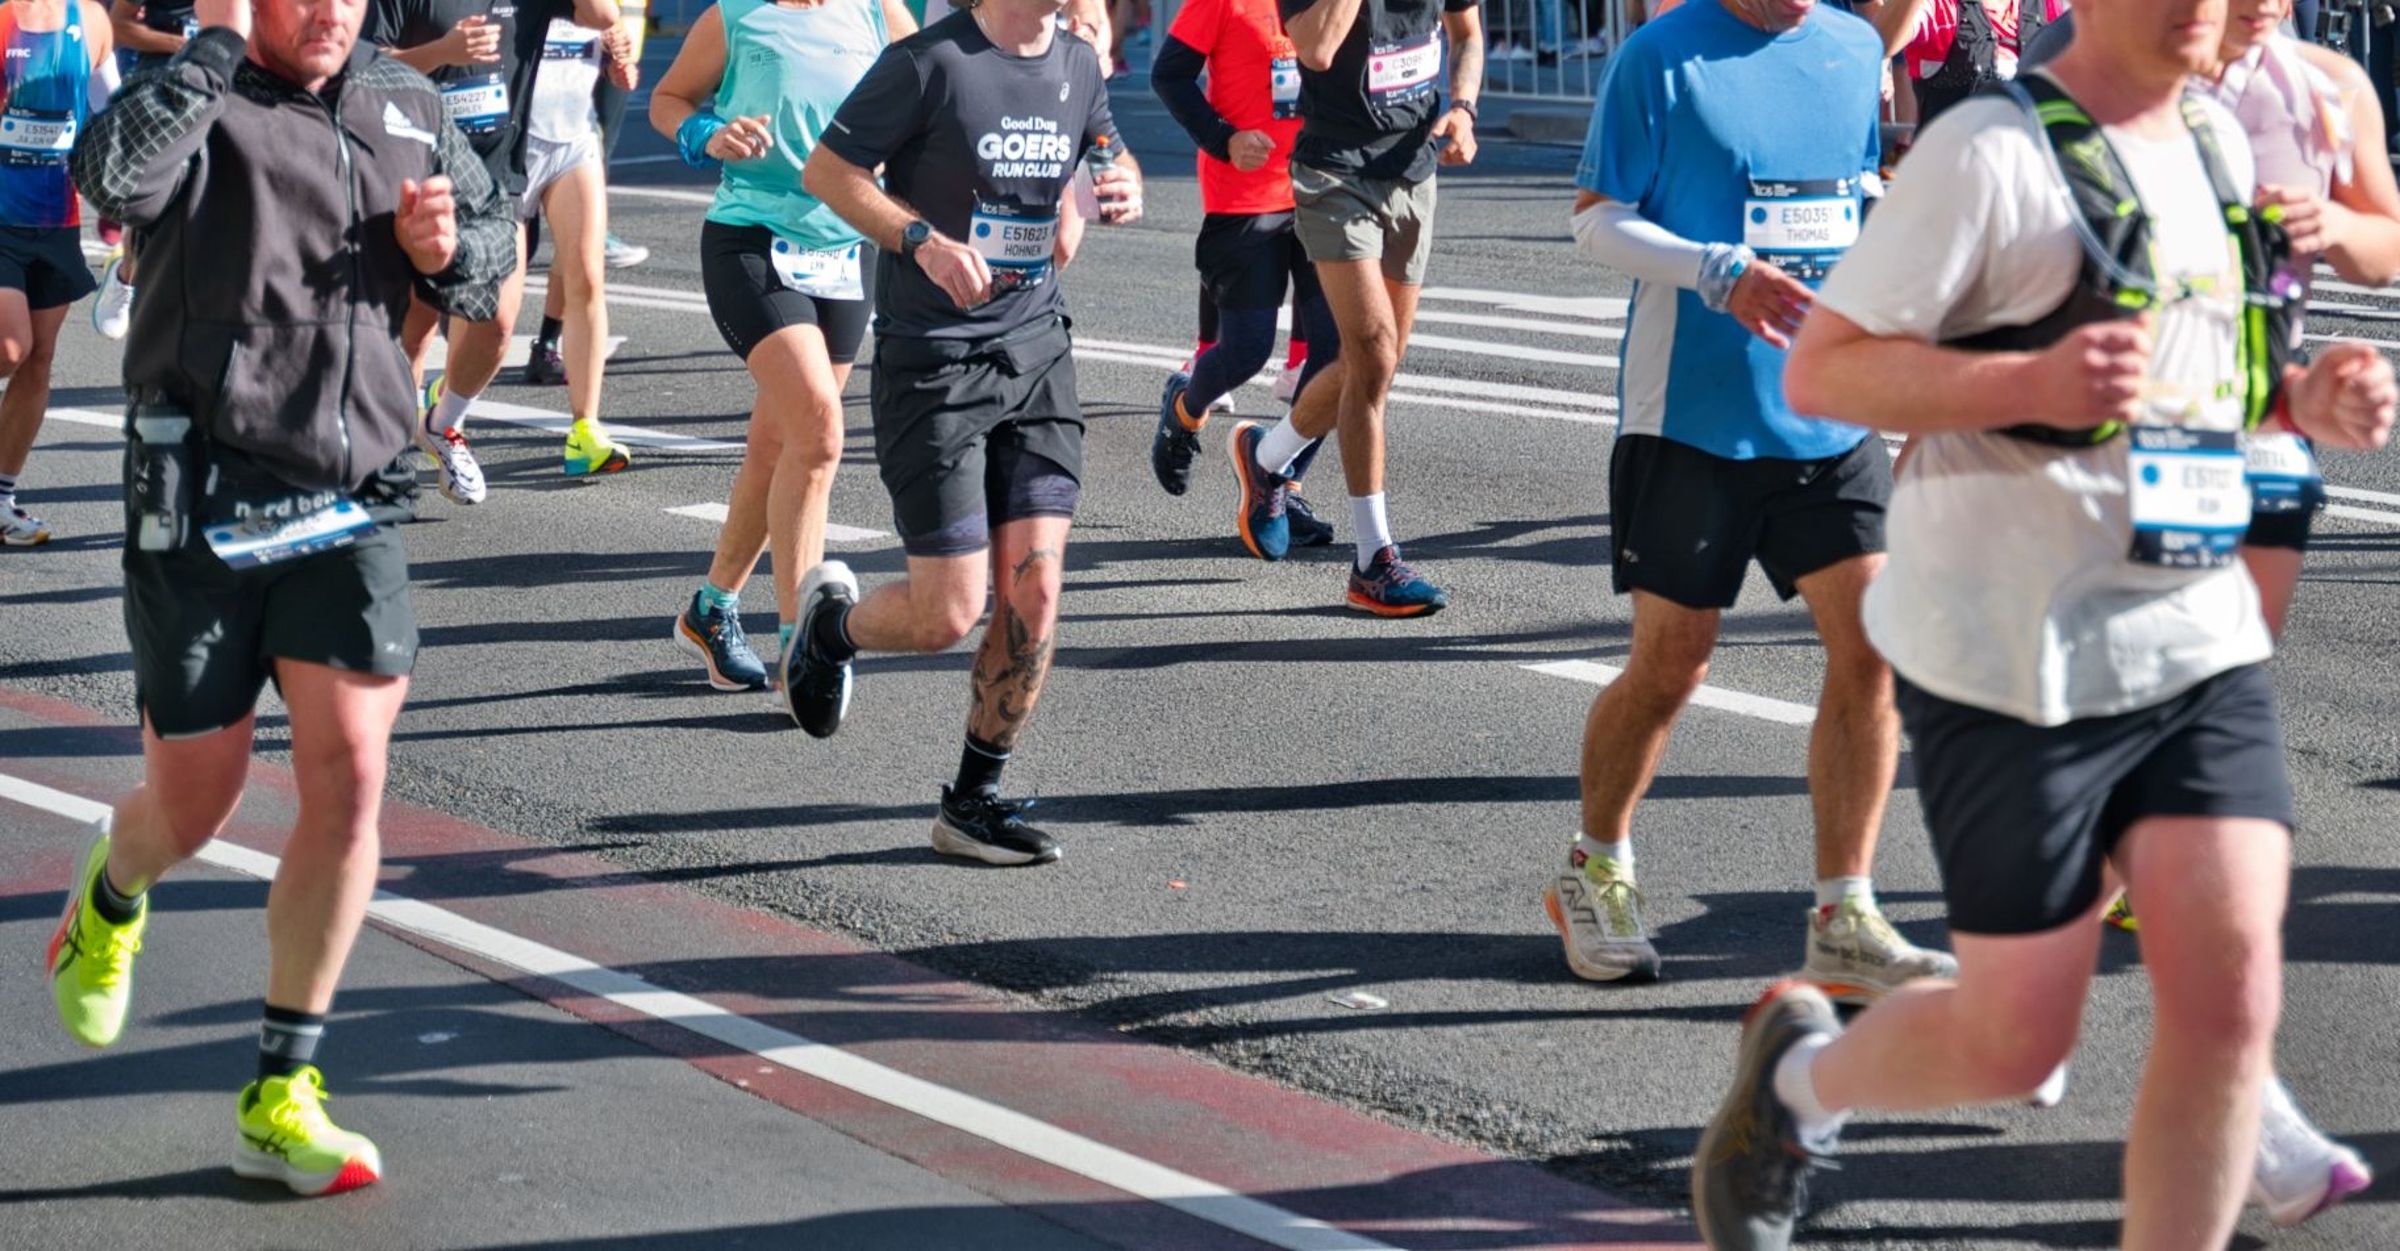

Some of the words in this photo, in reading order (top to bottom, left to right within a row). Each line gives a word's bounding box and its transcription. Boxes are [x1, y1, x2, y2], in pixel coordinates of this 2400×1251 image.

[1001, 116, 1033, 130] Good
[1035, 117, 1057, 133] Day
[977, 132, 1070, 162] GOERS
[992, 162, 1024, 177] RUN
[1025, 162, 1061, 178] CLUB
[1782, 207, 1832, 224] E5035
[1003, 226, 1048, 241] E51623
[1787, 228, 1829, 241] THOMAS
[234, 501, 291, 518] nrd
